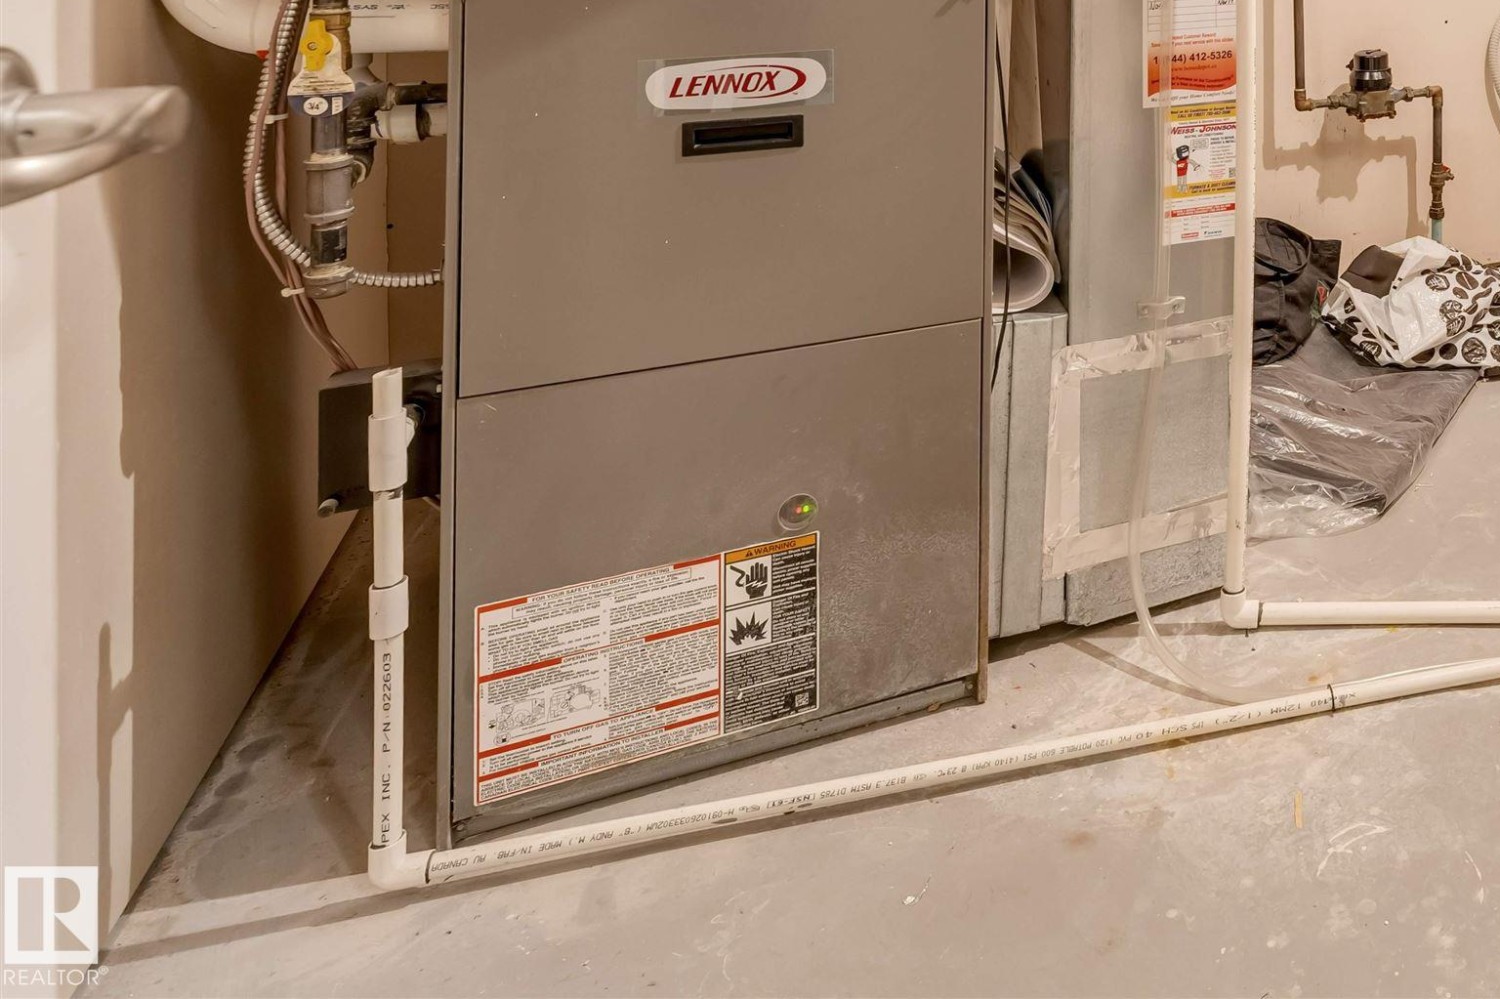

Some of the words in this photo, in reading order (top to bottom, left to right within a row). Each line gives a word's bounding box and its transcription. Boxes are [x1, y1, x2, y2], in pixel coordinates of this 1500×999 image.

[1189, 50, 1232, 61] 412-5326
[669, 71, 780, 98] LENNOX
[1199, 125, 1236, 133] JOHNSON
[754, 540, 796, 554] WARNING
[547, 591, 564, 599] YOUR
[566, 585, 589, 594] SAFETY
[591, 581, 607, 589] READ
[610, 575, 633, 584] BEFORE
[635, 566, 669, 578] OPERATING
[563, 650, 598, 663] OPERATING
[600, 639, 643, 654] INSTRUCTIONS
[382, 652, 390, 710] 022603
[1269, 703, 1301, 714] 12MM
[563, 728, 579, 736] TURN
[595, 720, 608, 728] GAS
[620, 707, 653, 721] APPLIANCE
[1190, 720, 1204, 729] IPS
[1135, 730, 1153, 739] 40
[1160, 724, 1187, 734] SCH
[382, 721, 390, 752] P/N
[1117, 734, 1132, 743] PVC
[540, 752, 576, 767] IMPORTANT
[578, 739, 619, 756] INFORMATION
[631, 727, 663, 741] INSTALLER
[1040, 748, 1056, 757] 600
[1059, 741, 1092, 754] POTABLE
[1022, 751, 1038, 761] PSI
[382, 764, 390, 800] INC.
[849, 782, 872, 793] ASTM
[874, 775, 906, 788] B137.3
[818, 787, 847, 798] D1785
[587, 829, 614, 842] ANDY
[536, 839, 563, 852] MADE
[430, 856, 469, 872] CANADA
